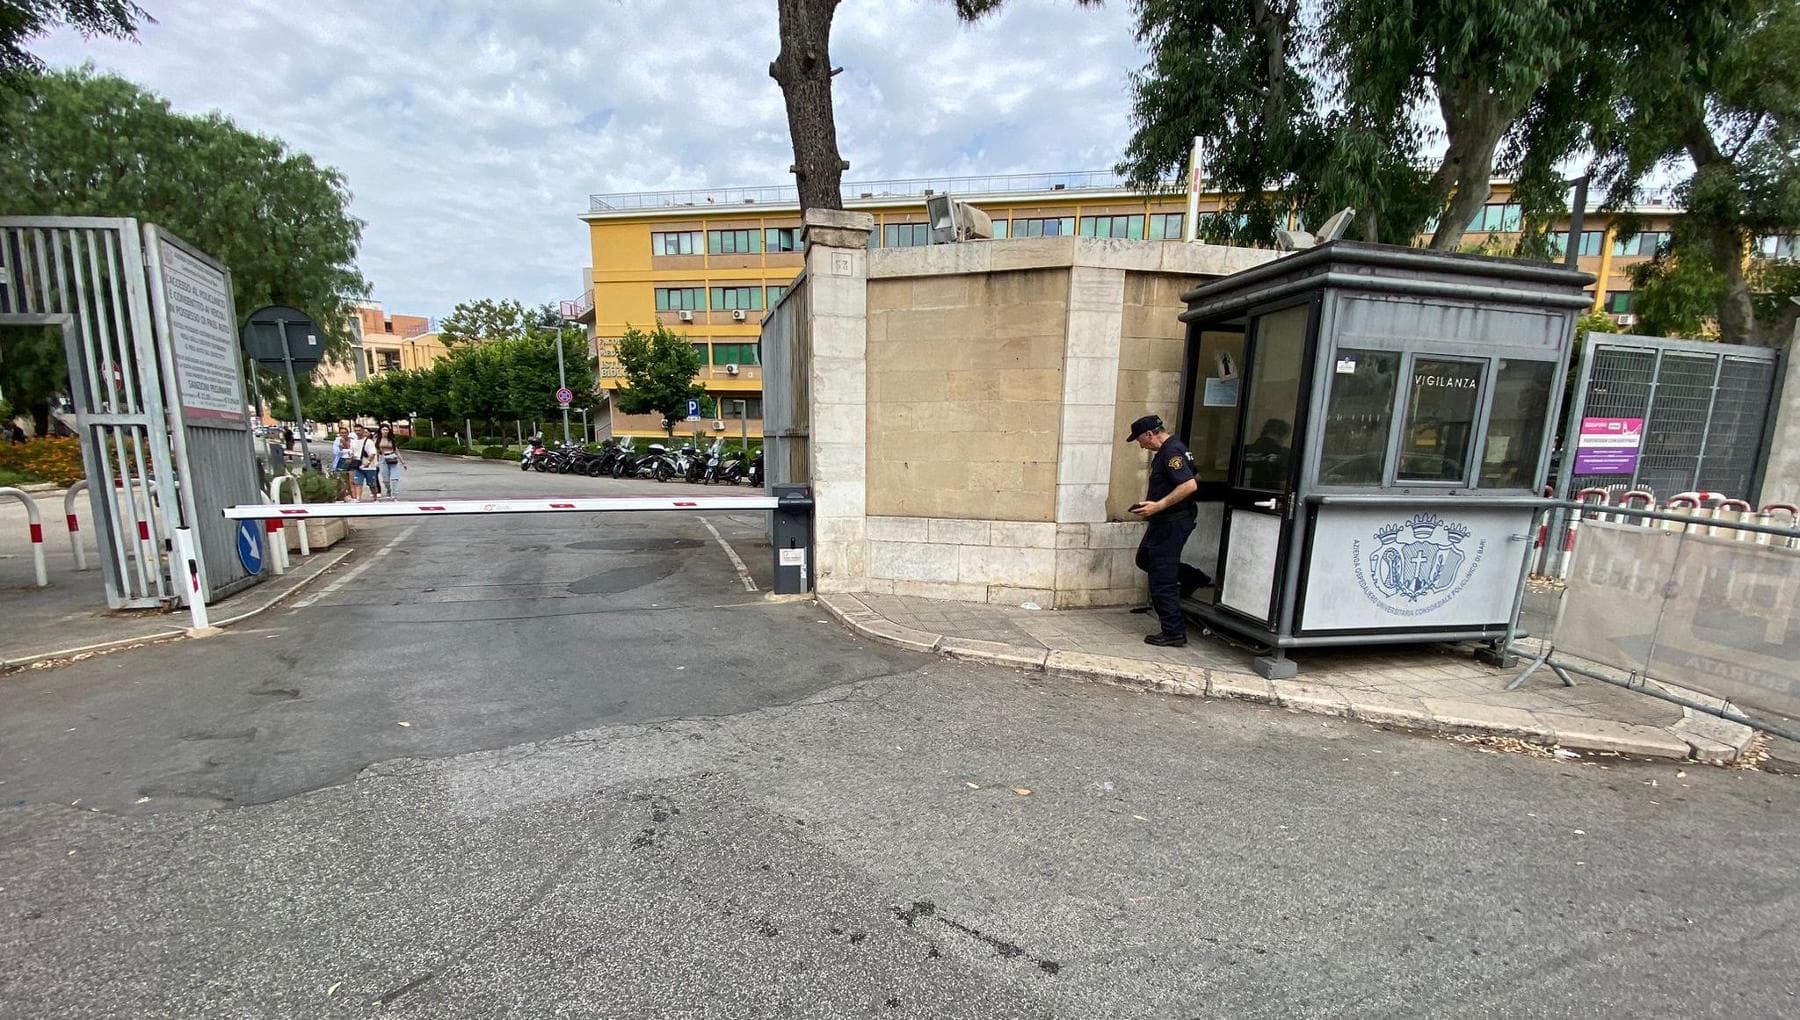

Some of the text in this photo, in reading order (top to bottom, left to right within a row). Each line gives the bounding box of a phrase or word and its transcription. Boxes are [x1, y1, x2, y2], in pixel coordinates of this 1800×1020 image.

[1414, 374, 1477, 389] VIGILANZA
[689, 401, 697, 415] P
[1353, 538, 1361, 569] AZIENDA
